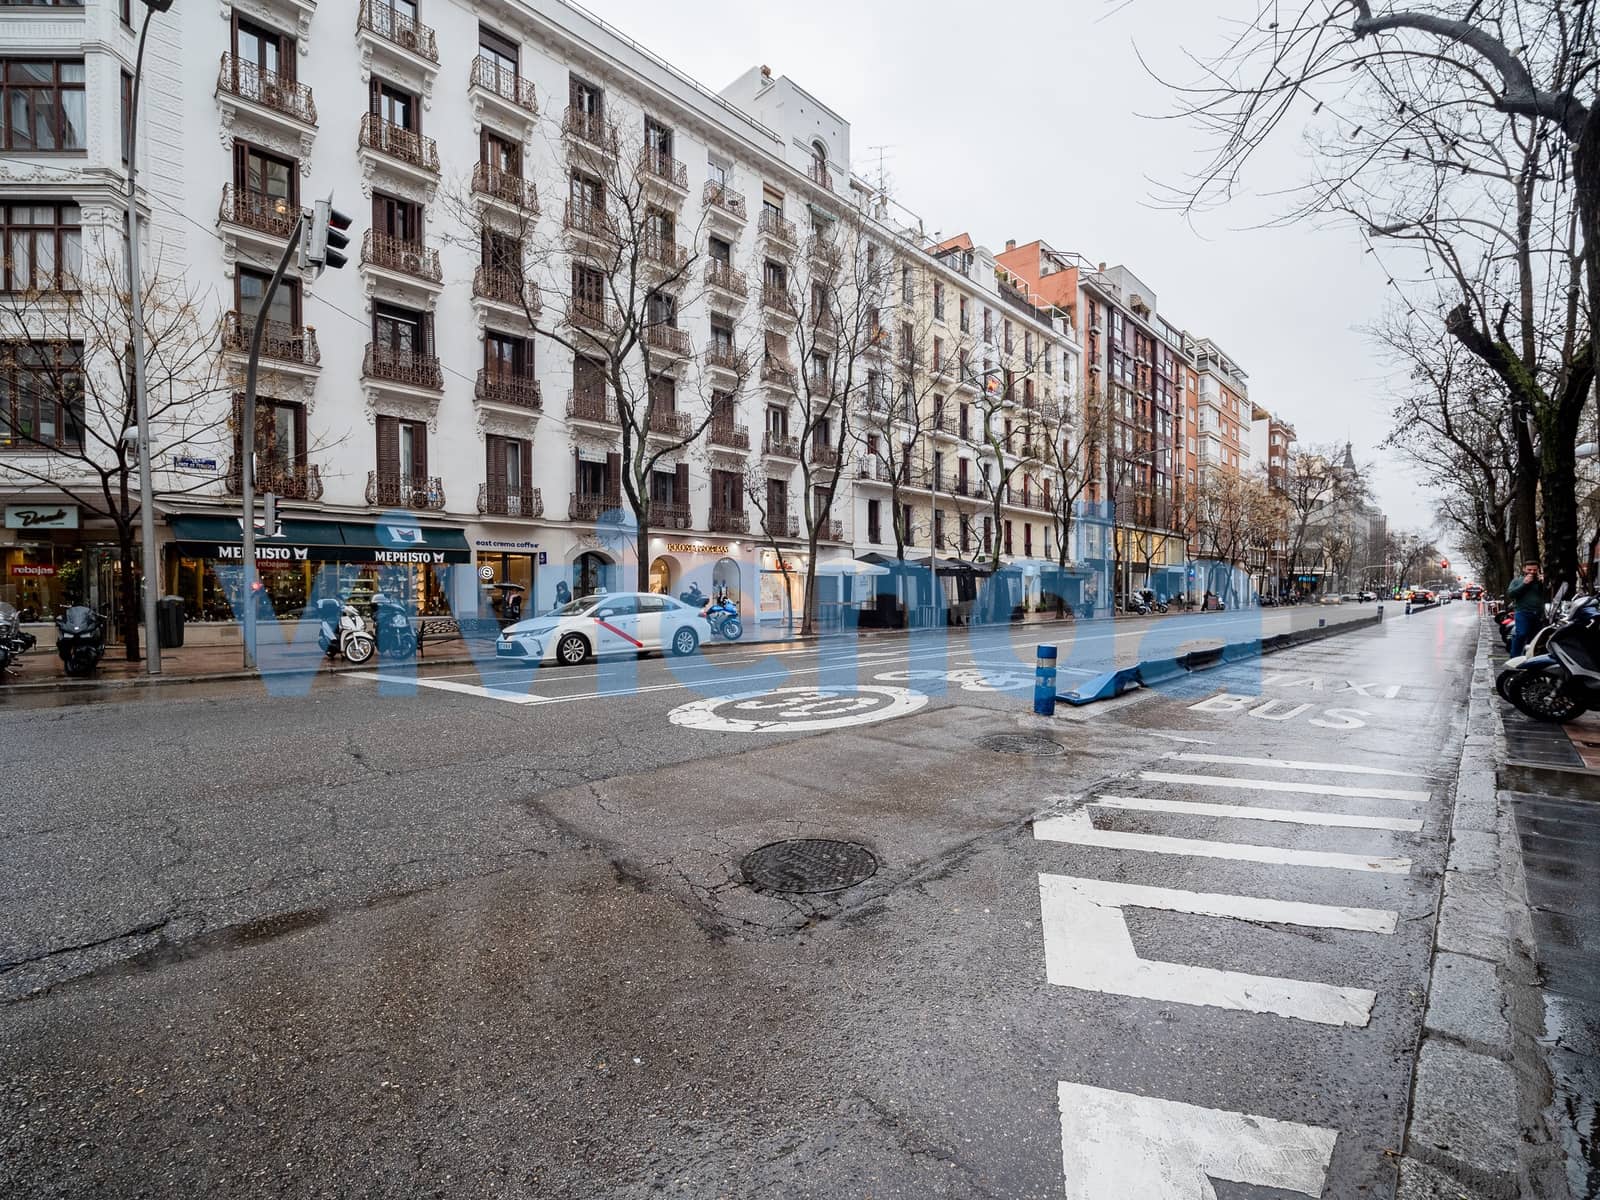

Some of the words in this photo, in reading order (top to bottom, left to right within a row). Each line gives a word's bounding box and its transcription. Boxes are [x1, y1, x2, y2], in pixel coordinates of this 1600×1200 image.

[493, 540, 516, 548] crema
[375, 551, 431, 563] MEPHISTO
[13, 565, 55, 576] rebajas
[1186, 693, 1375, 730] BUS
